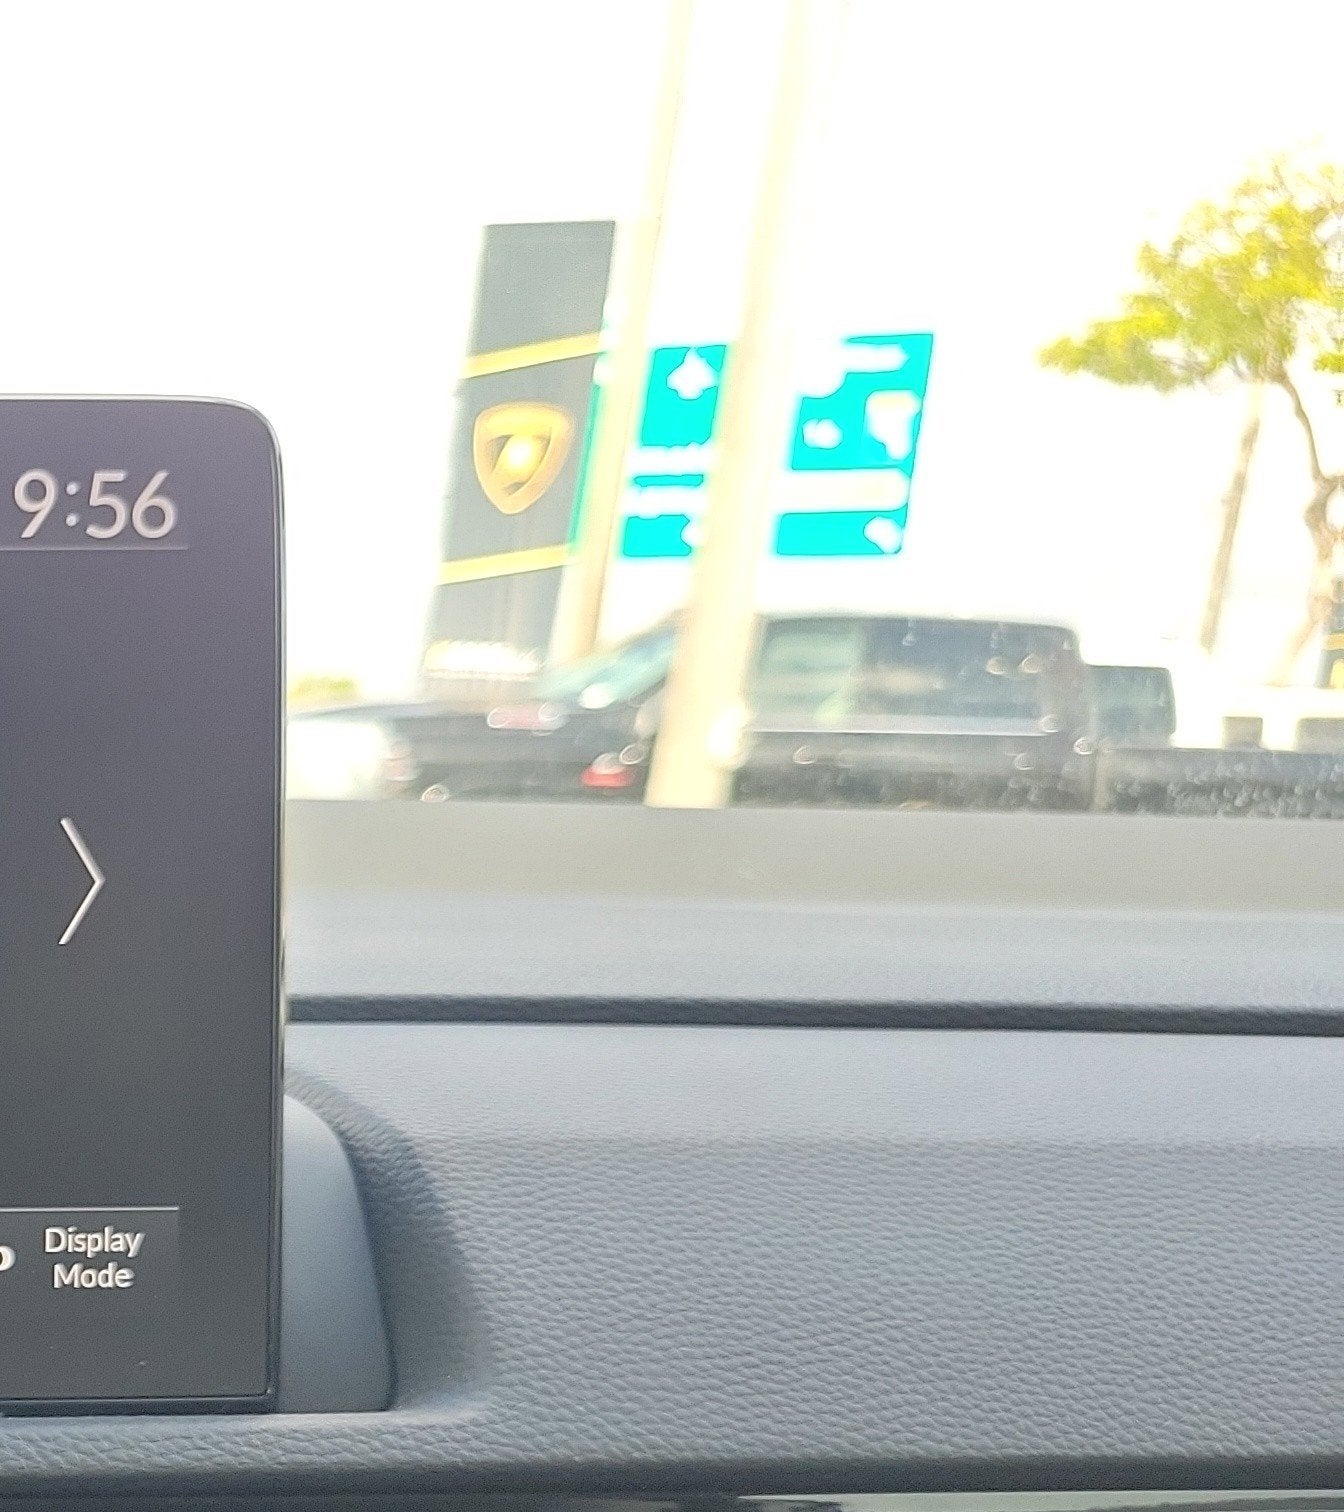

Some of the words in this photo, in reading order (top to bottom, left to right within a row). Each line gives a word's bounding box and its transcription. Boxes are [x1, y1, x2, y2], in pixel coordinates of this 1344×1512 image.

[14, 469, 178, 539] 9:56
[44, 1226, 144, 1258] Display
[52, 1264, 133, 1290] Mode
